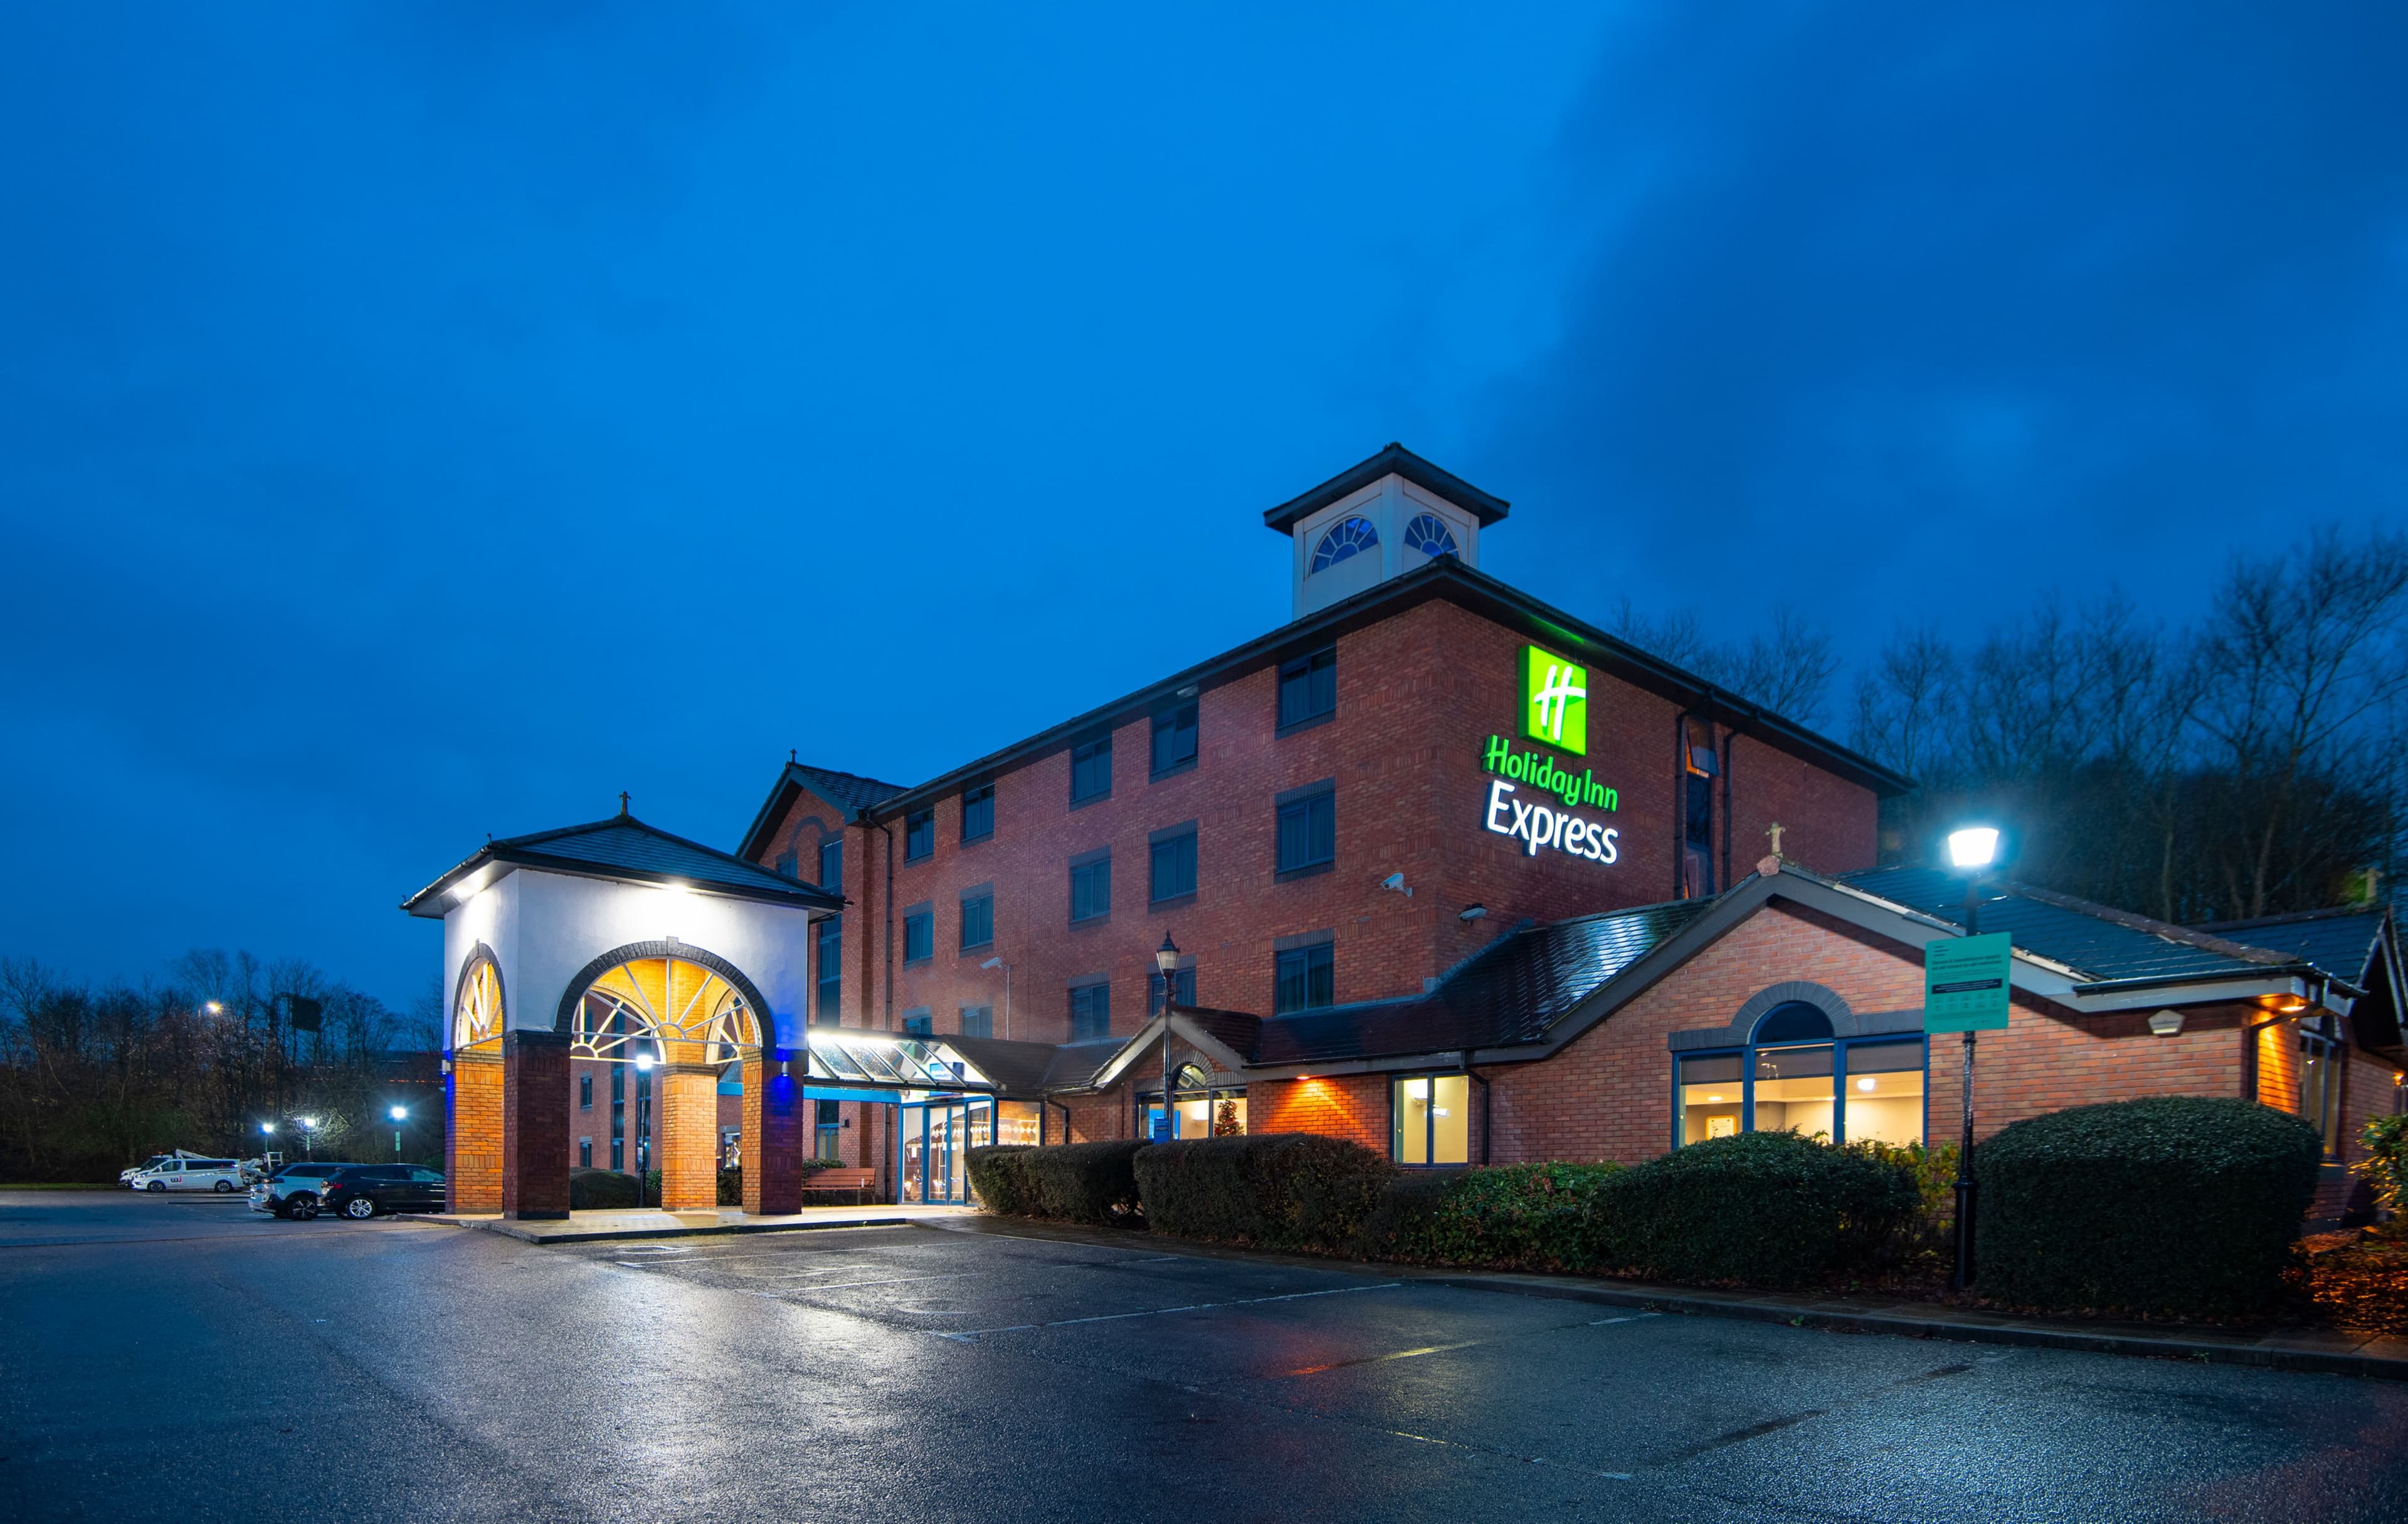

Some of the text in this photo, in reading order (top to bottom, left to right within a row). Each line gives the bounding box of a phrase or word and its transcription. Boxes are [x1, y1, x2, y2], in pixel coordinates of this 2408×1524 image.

[1482, 734, 1619, 812] Holiday Inn
[1487, 779, 1619, 865] Express
